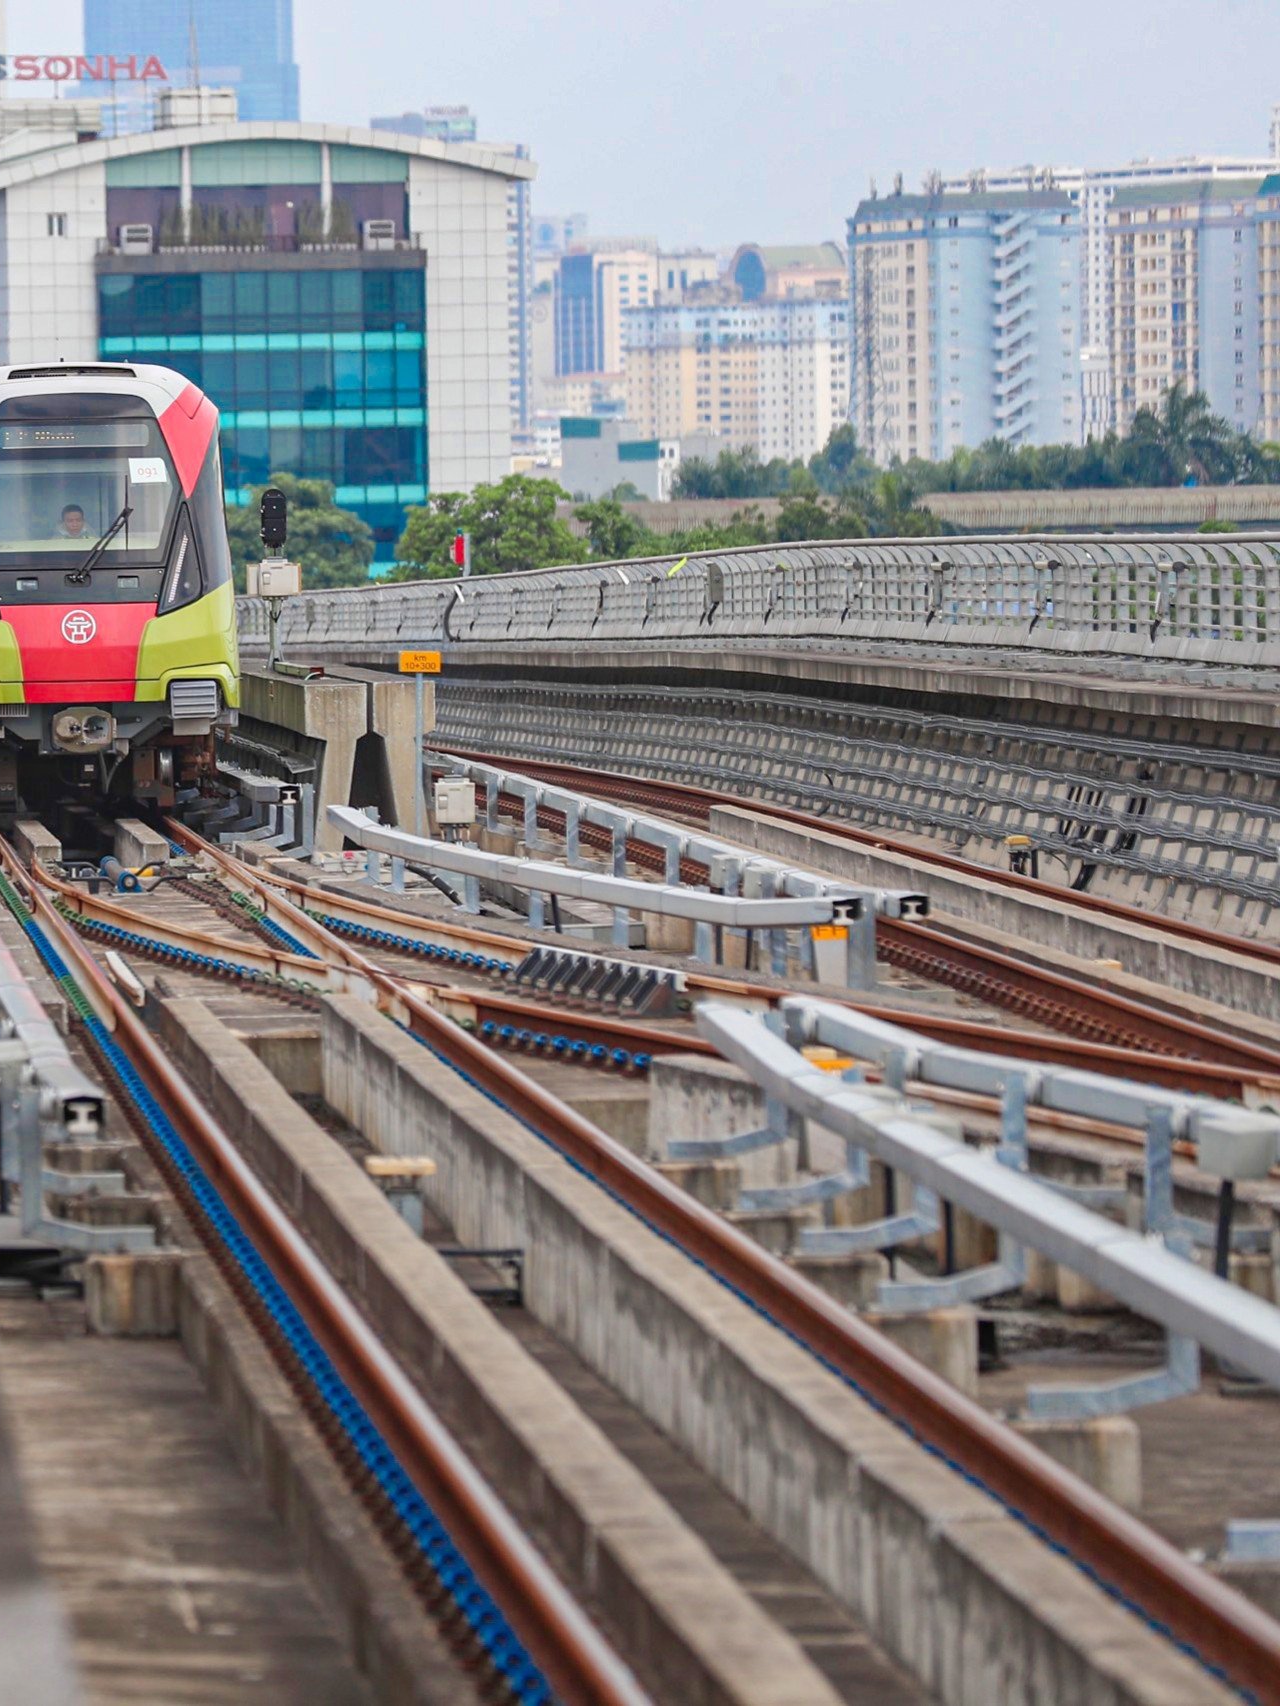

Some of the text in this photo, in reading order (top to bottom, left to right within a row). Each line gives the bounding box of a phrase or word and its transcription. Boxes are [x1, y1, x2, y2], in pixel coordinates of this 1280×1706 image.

[14, 54, 168, 81] SONHA
[137, 467, 158, 477] 091
[405, 662, 436, 670] 10+300
